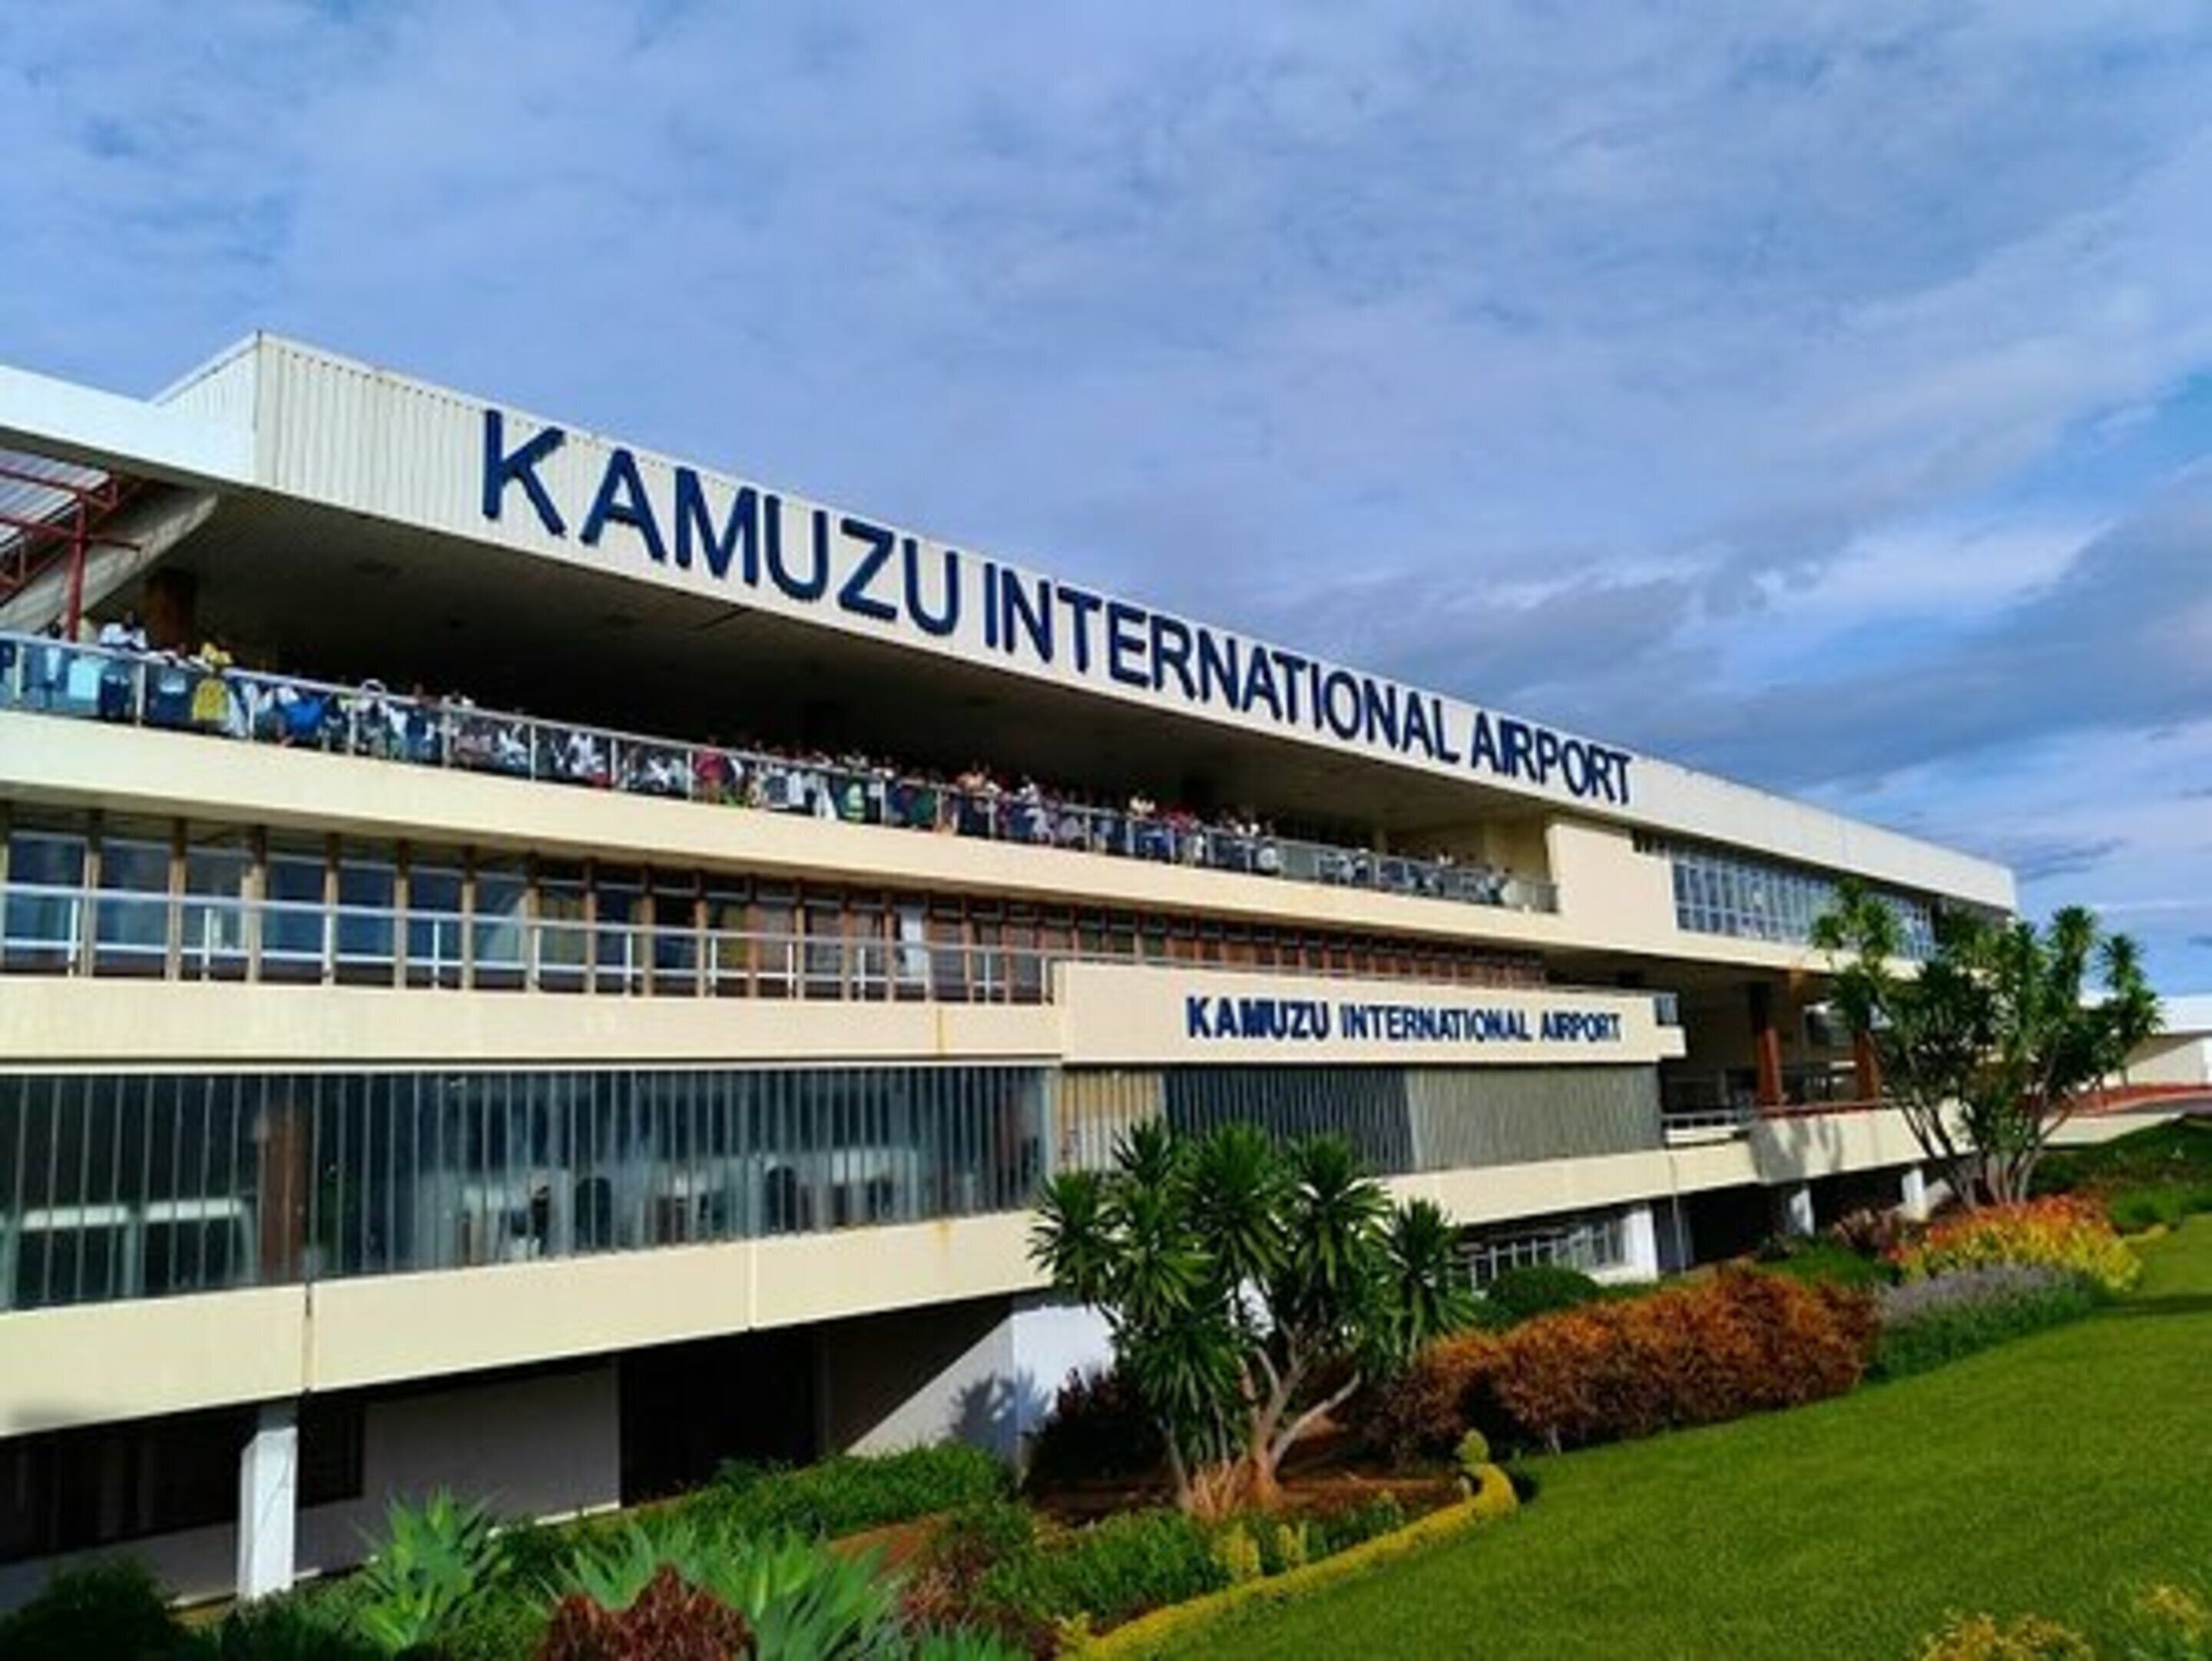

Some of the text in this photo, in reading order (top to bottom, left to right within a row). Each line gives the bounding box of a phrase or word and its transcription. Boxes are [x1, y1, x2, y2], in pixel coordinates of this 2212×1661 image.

[482, 409, 1632, 805] KAMUZU INTERNATIONAL AIRPORT
[1186, 997, 1622, 1042] KAMUZU INTERNATIONAL AIRPORT
